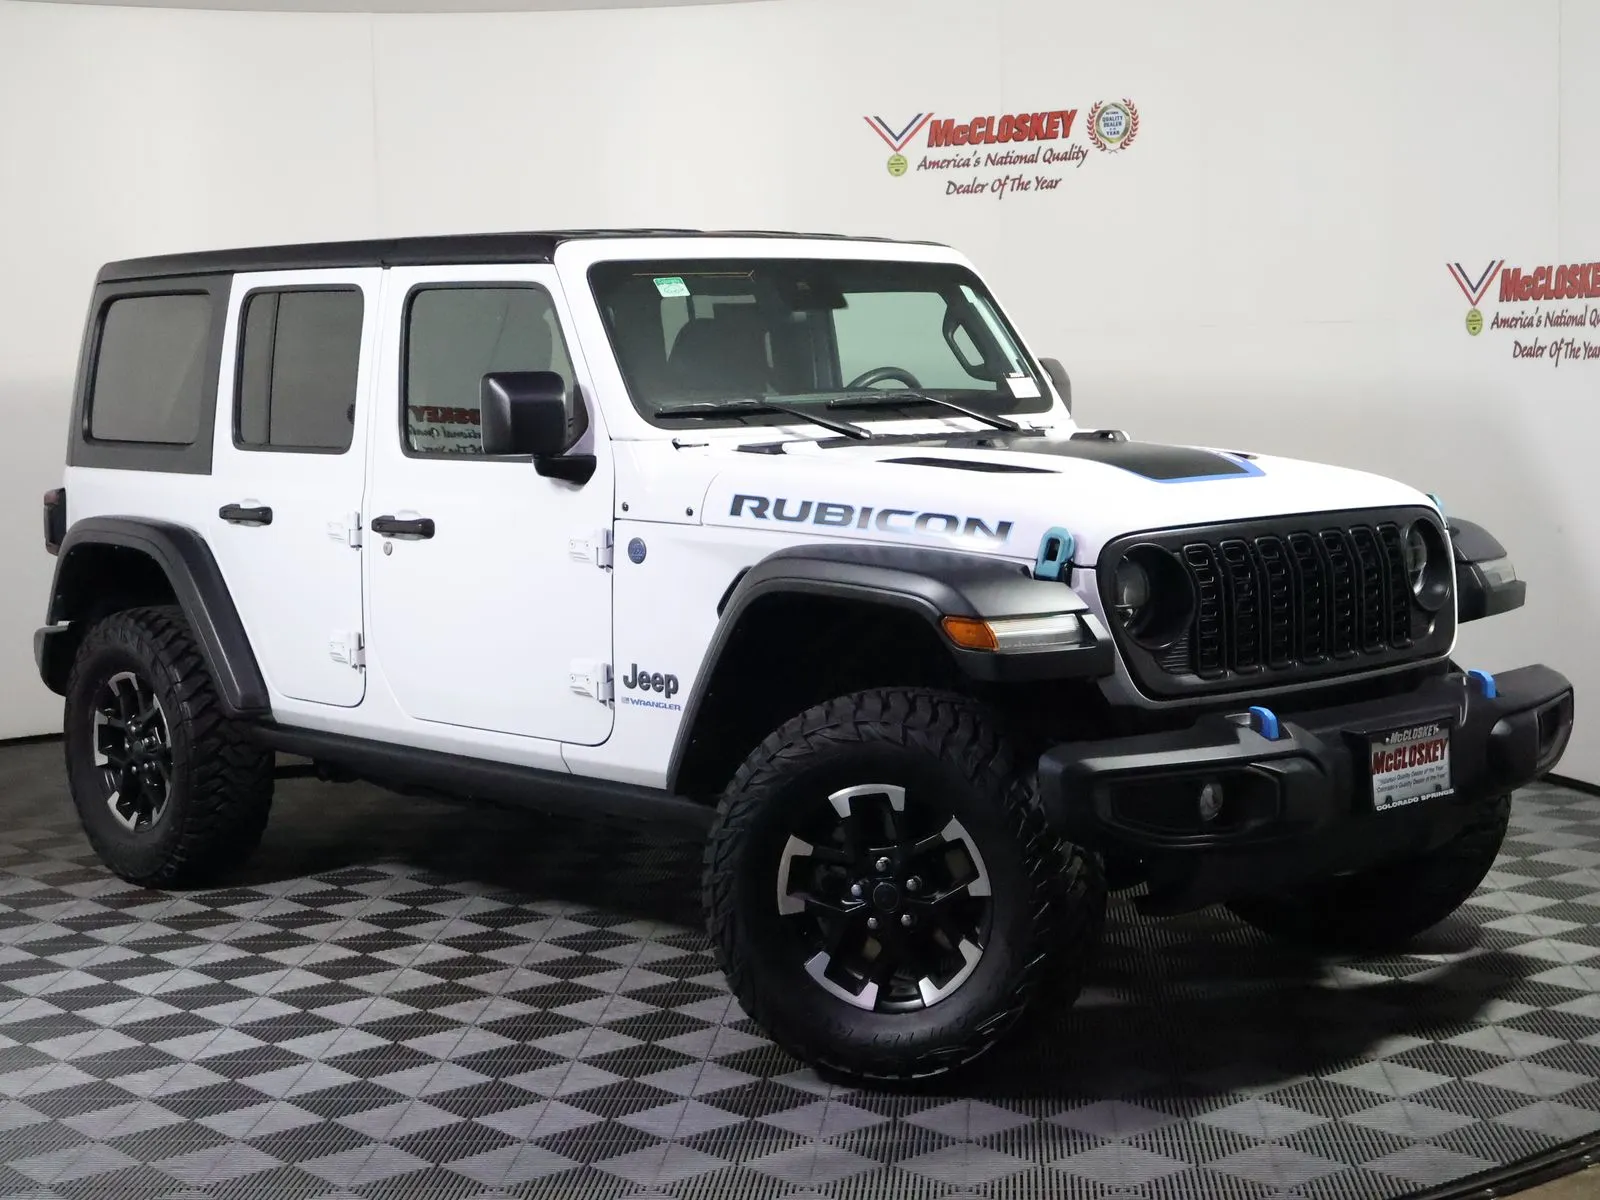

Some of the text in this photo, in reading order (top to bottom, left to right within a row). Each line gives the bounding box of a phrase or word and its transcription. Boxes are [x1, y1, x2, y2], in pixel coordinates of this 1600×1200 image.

[927, 109, 1078, 148] McCLOSKEY
[916, 150, 981, 171] America's
[984, 146, 1041, 167] National
[1042, 143, 1089, 168] Quality
[945, 174, 1062, 200] Dealer Of The Year
[1499, 262, 1600, 302] McCLOSKE
[1490, 306, 1542, 330] America's
[1543, 304, 1588, 328] National
[1512, 336, 1547, 359] Dealer
[1548, 336, 1564, 368] Of
[1564, 337, 1581, 359] The
[729, 493, 1014, 543] RUBICON
[623, 663, 679, 699] Jeep
[629, 698, 681, 711] WRANGLER
[1390, 724, 1440, 744] McCLOSKEY
[1372, 738, 1449, 775] McCLOSKEY
[1376, 788, 1455, 811] COLORADO SPRINGS
